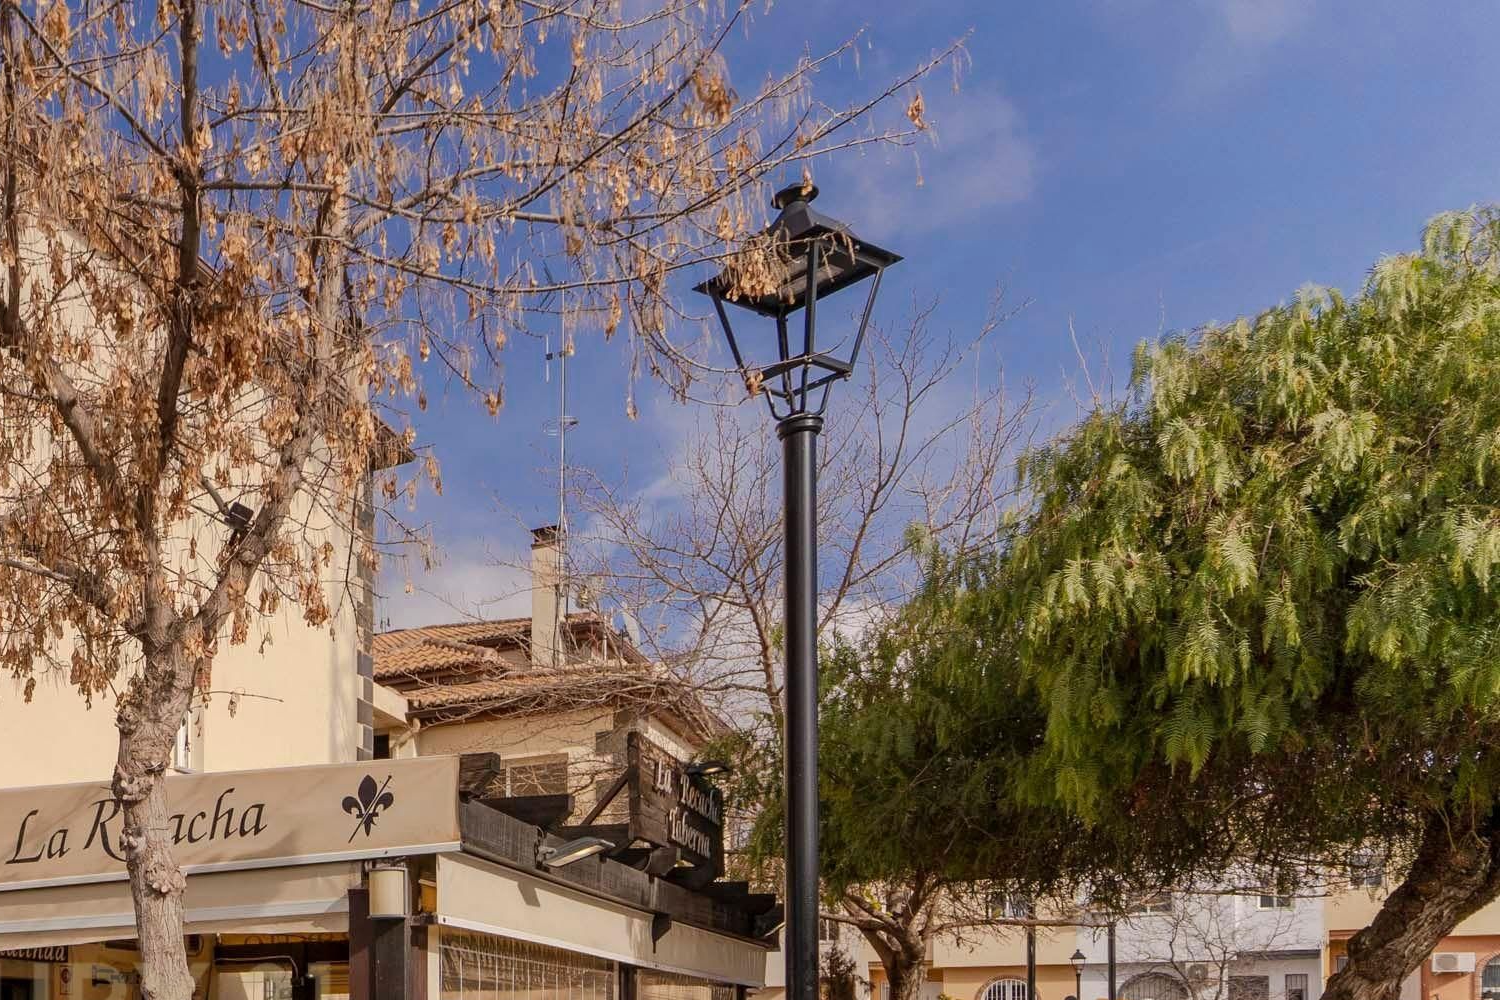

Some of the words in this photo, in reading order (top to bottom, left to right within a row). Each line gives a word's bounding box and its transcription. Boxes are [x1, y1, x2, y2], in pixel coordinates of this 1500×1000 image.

[4, 810, 71, 866] La
[82, 787, 268, 863] Racha
[669, 806, 712, 859] Taberna
